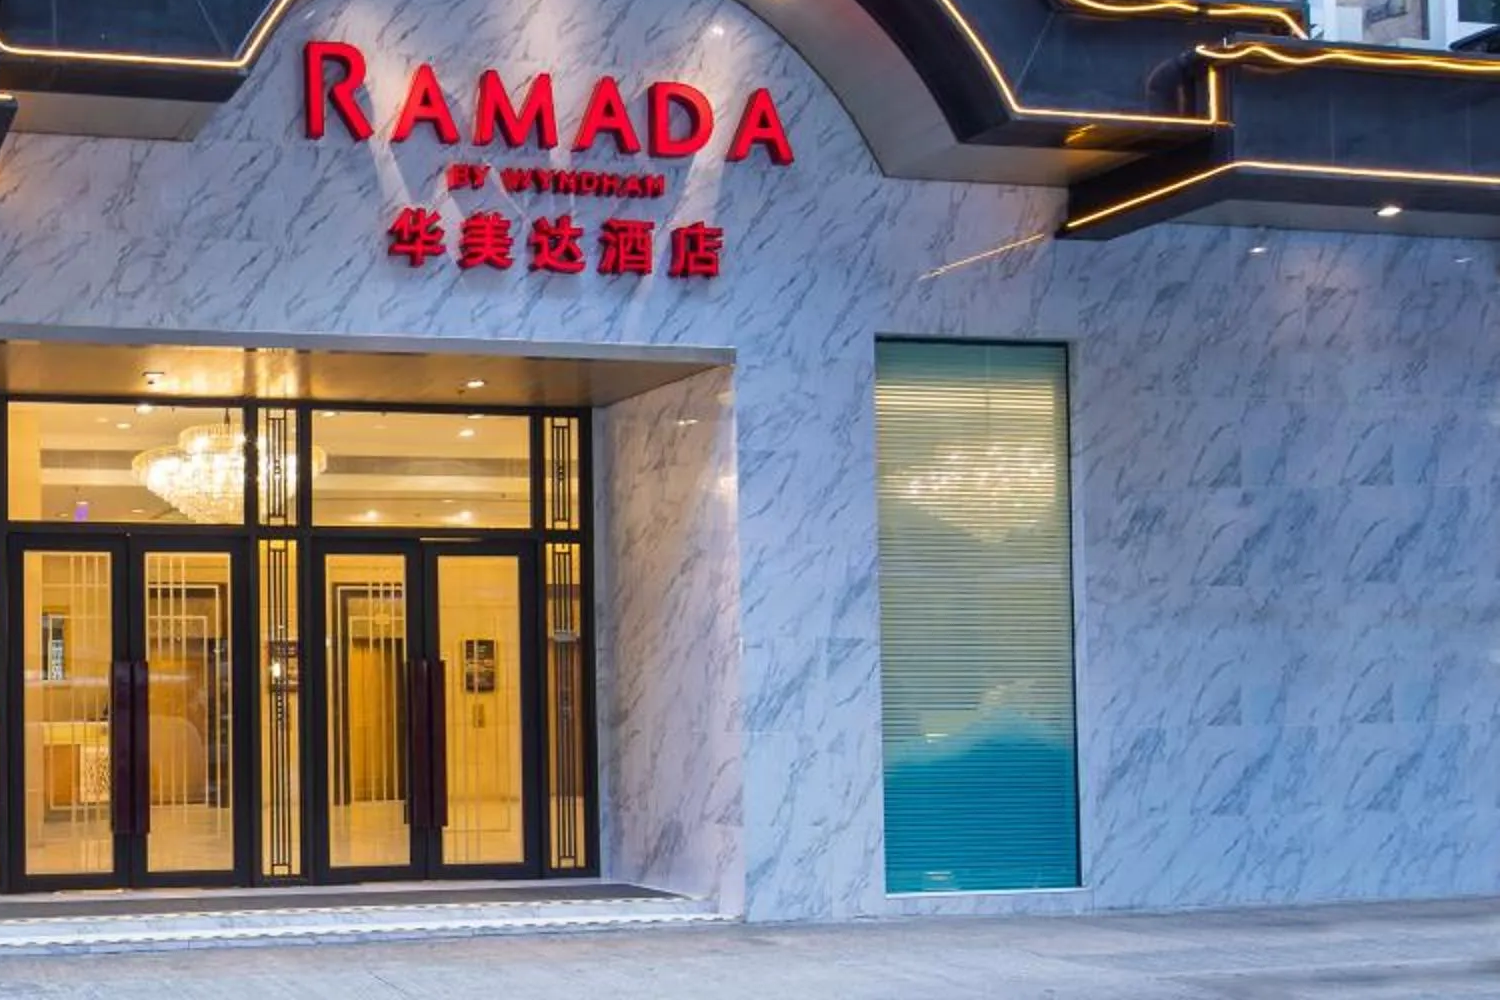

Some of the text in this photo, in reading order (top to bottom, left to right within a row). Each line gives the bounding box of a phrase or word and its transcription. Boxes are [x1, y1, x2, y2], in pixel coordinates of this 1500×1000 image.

[304, 40, 795, 165] RAMADA
[446, 163, 665, 198] BY WYNDHAM
[388, 206, 723, 279] 华美达酒店
